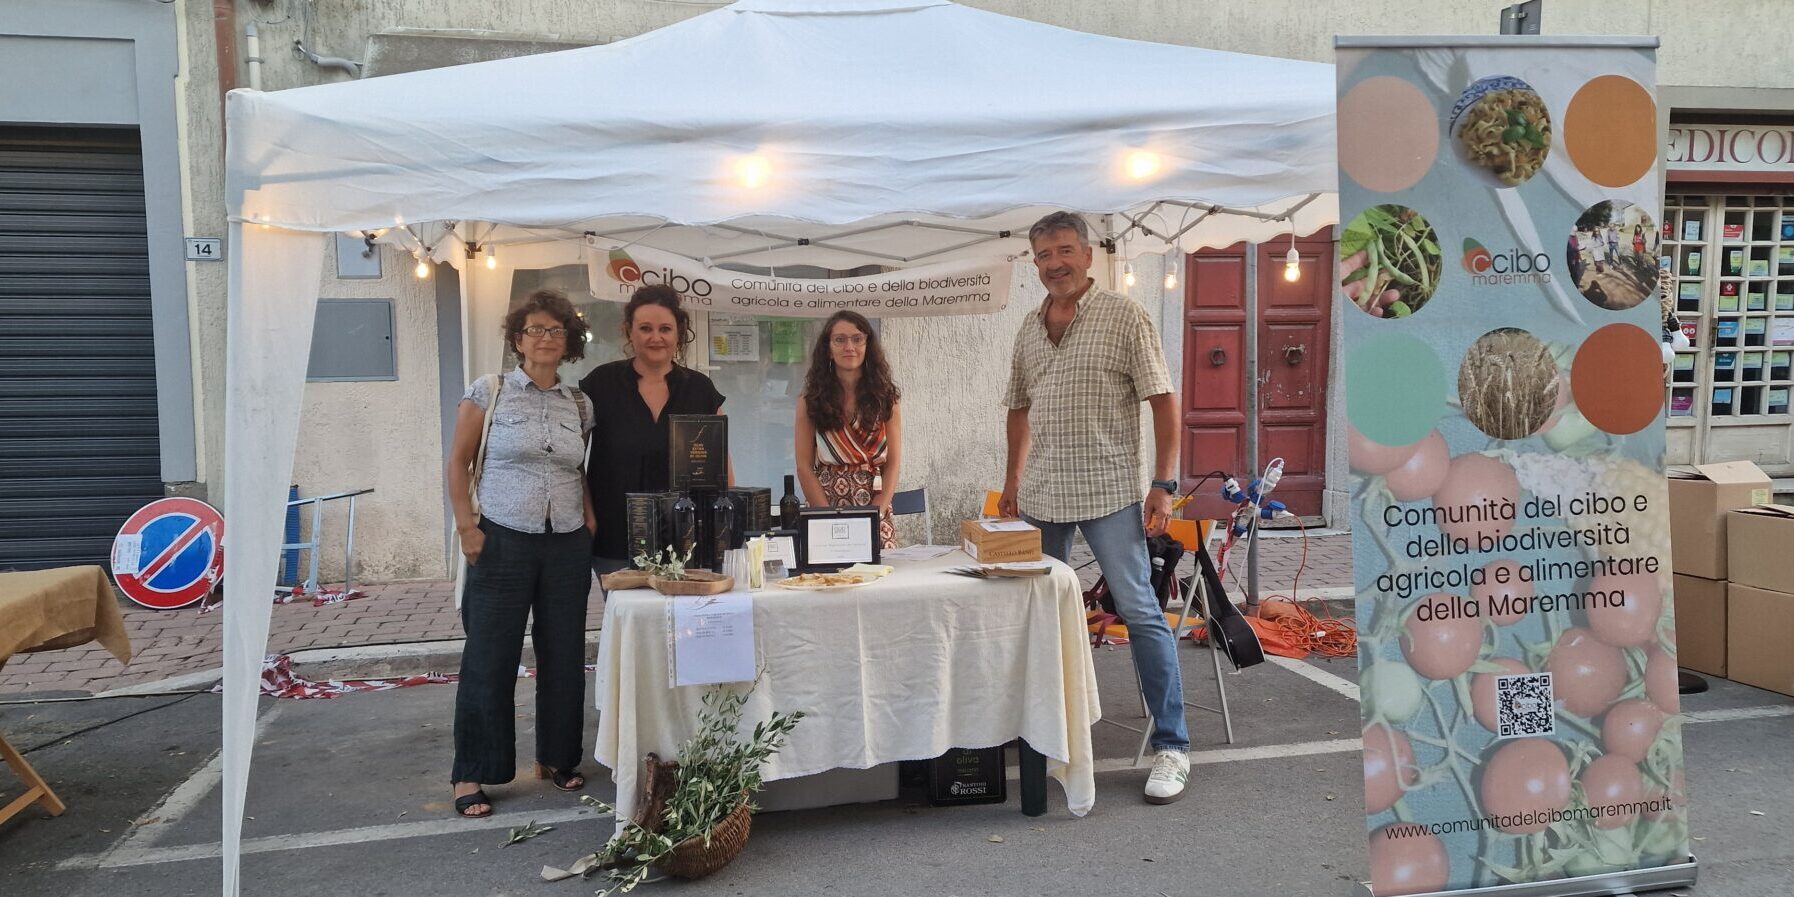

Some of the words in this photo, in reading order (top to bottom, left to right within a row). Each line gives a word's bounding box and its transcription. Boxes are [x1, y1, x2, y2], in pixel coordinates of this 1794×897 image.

[194, 243, 212, 255] 14
[806, 283, 828, 294] del
[833, 283, 864, 293] cibo
[868, 282, 877, 292] e
[881, 280, 915, 292] della
[919, 273, 991, 290] biodiversità
[1472, 273, 1551, 285] maremma
[731, 296, 789, 307] agricola
[794, 299, 803, 308] e
[807, 298, 881, 308] alimentare
[885, 297, 918, 308] della
[922, 292, 991, 306] Maremma
[1384, 497, 1516, 528] Comunità
[1524, 494, 1562, 519] del
[1569, 492, 1626, 516] cibo
[1633, 494, 1648, 512] e
[1406, 534, 1469, 558] della
[1478, 522, 1630, 553] biodiversità
[1377, 564, 1486, 598] agricola
[1495, 566, 1510, 584] e
[1518, 555, 1659, 582] alimentare
[1417, 597, 1480, 622] della
[1489, 589, 1625, 616] Maremma
[960, 786, 987, 795] ROSSI
[1385, 796, 1672, 840] www.comunitadelcibomaremma.it
